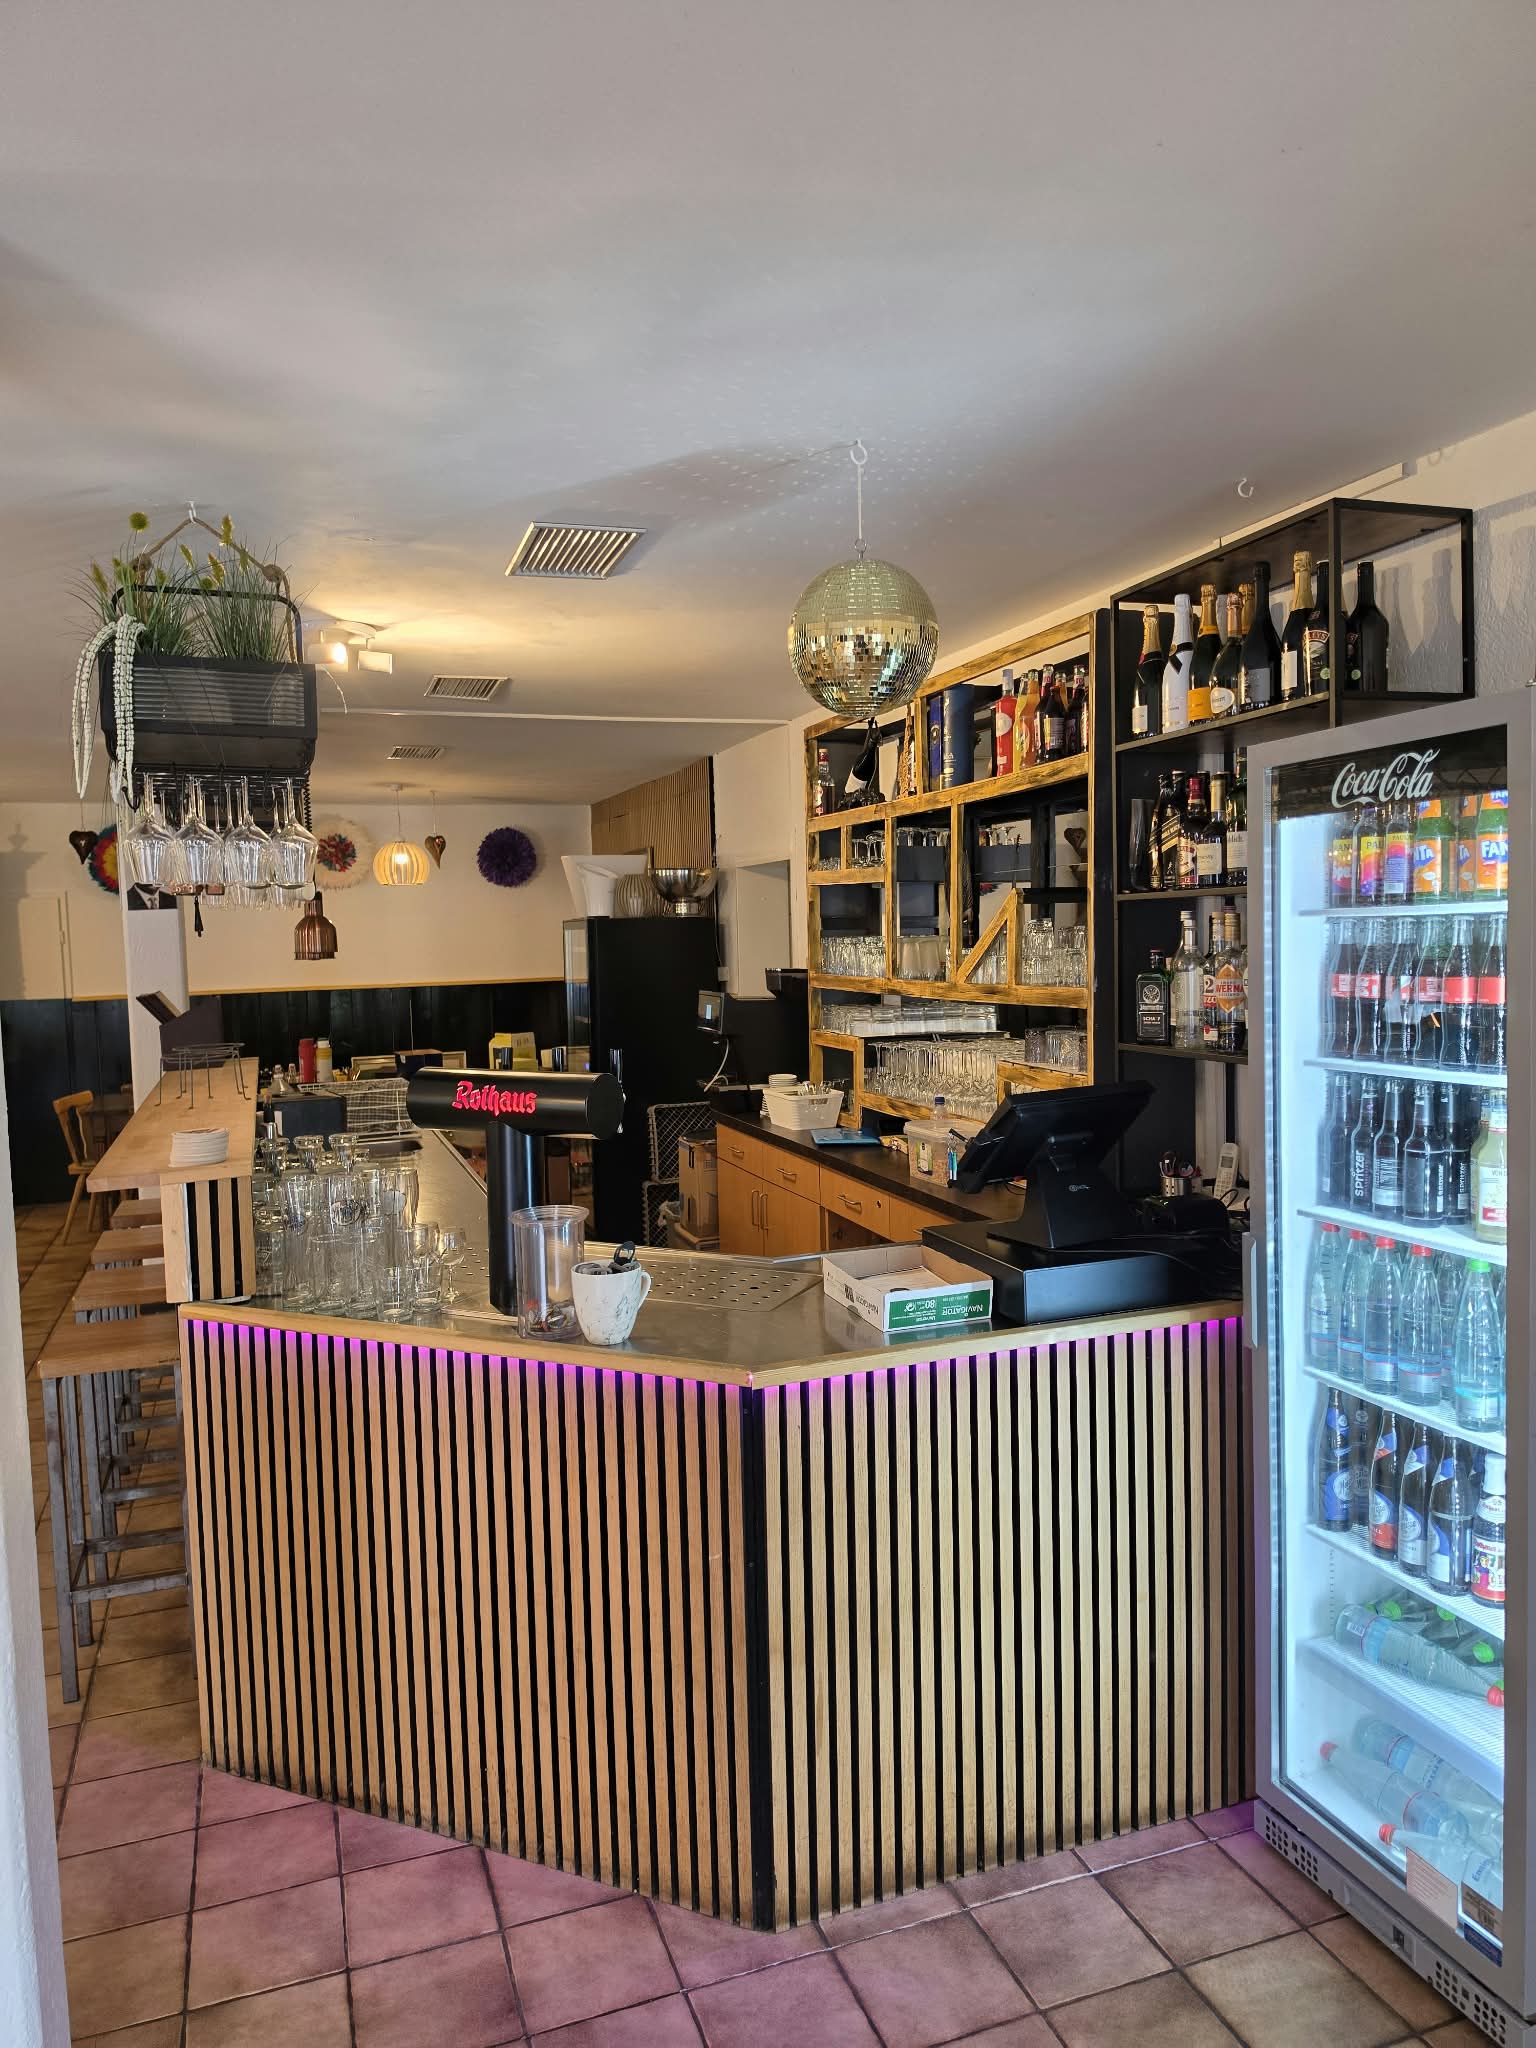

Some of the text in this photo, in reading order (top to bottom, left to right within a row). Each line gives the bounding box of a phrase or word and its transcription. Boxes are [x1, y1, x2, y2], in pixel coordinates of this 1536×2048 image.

[452, 1080, 538, 1116] Rothaus
[925, 1299, 936, 1309] 80
[942, 1303, 983, 1317] NAVIGATOR
